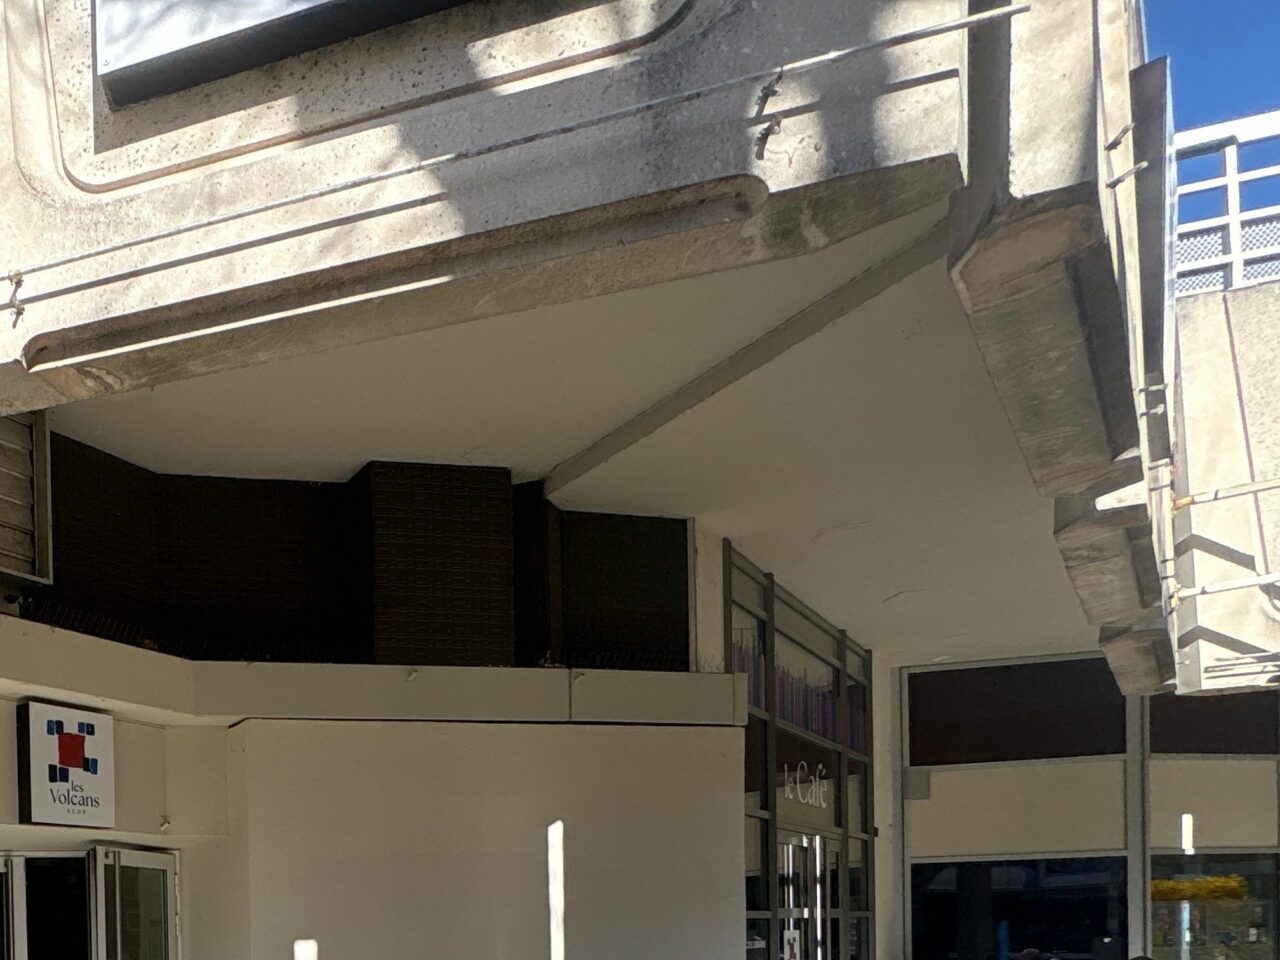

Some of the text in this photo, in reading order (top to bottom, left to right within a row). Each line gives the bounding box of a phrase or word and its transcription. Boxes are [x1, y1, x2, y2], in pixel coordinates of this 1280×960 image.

[71, 780, 84, 792] les
[784, 761, 827, 809] le Café
[50, 788, 100, 808] Volcans
